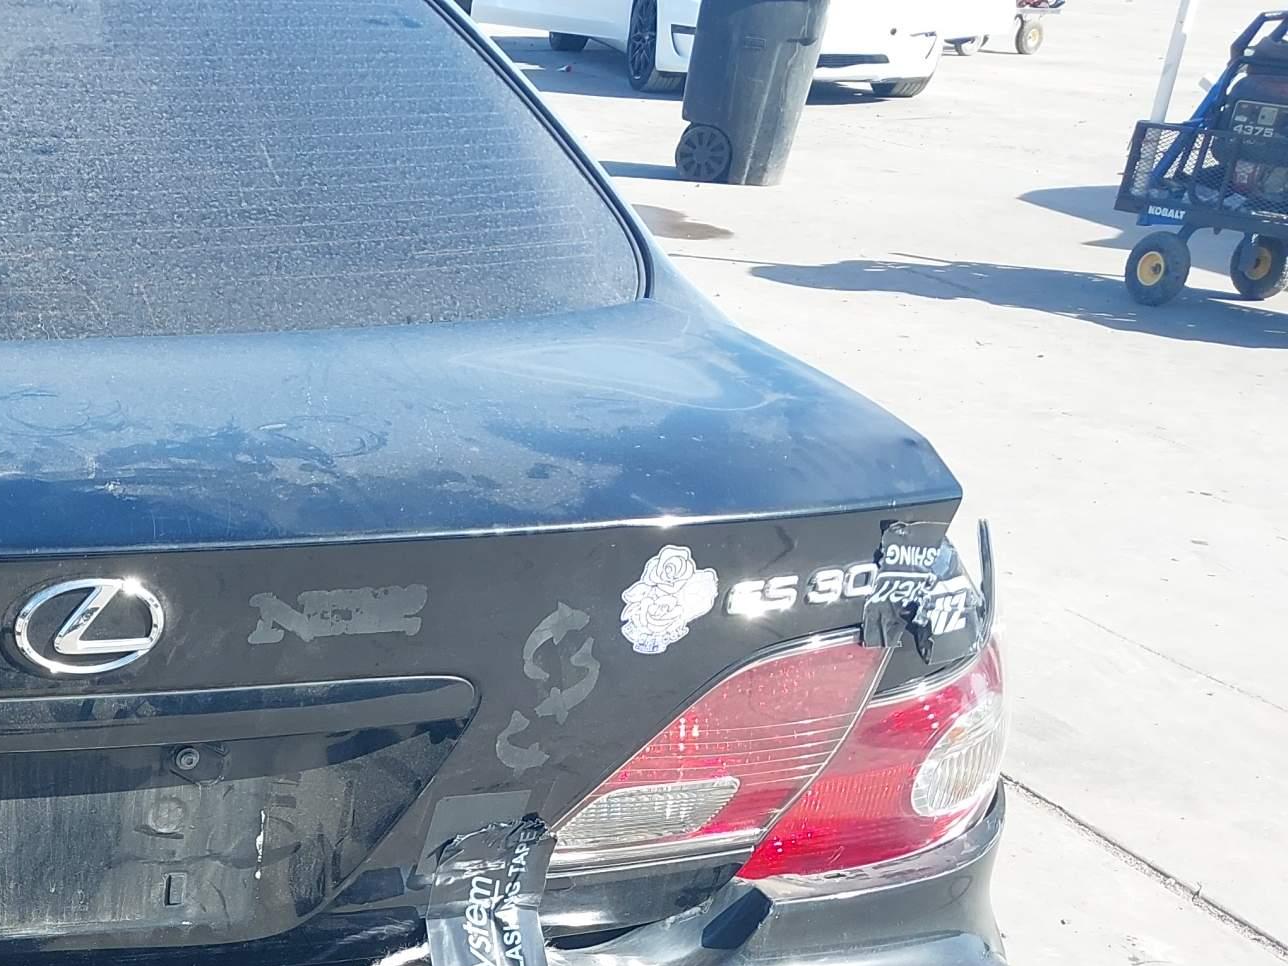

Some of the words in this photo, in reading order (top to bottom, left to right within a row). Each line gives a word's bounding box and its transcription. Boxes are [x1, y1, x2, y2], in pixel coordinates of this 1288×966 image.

[1147, 204, 1186, 220] KOBALT
[885, 544, 940, 567] SHING
[726, 575, 800, 618] ES
[806, 562, 879, 604] 30
[507, 829, 537, 877] TAPE
